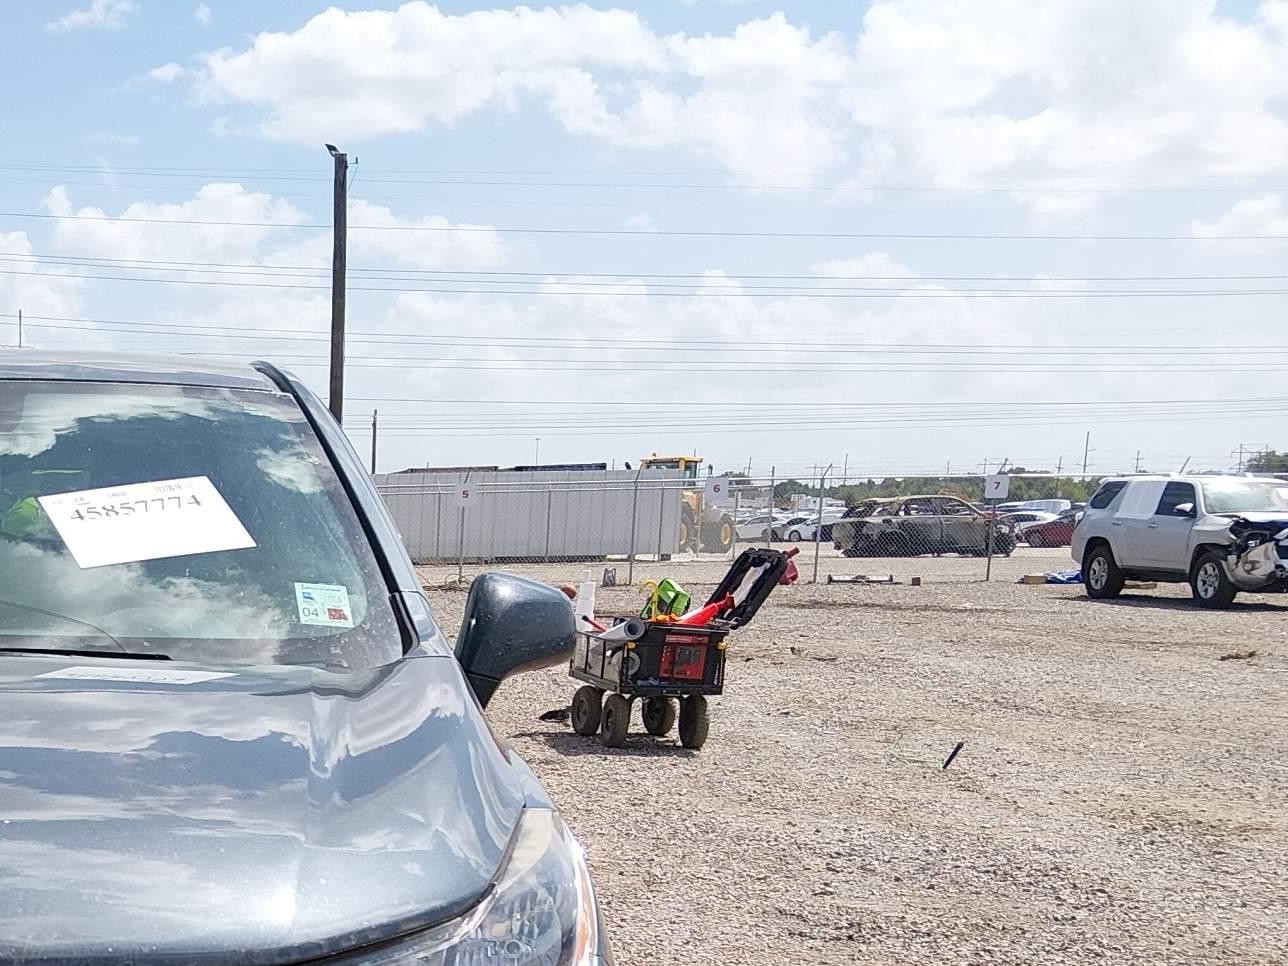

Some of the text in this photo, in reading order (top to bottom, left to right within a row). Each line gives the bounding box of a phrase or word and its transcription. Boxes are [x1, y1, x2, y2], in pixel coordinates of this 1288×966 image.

[712, 483, 721, 493] 6
[993, 481, 1001, 491] 7
[462, 489, 469, 499] 5
[70, 493, 203, 522] 45857774
[302, 607, 319, 617] 04
